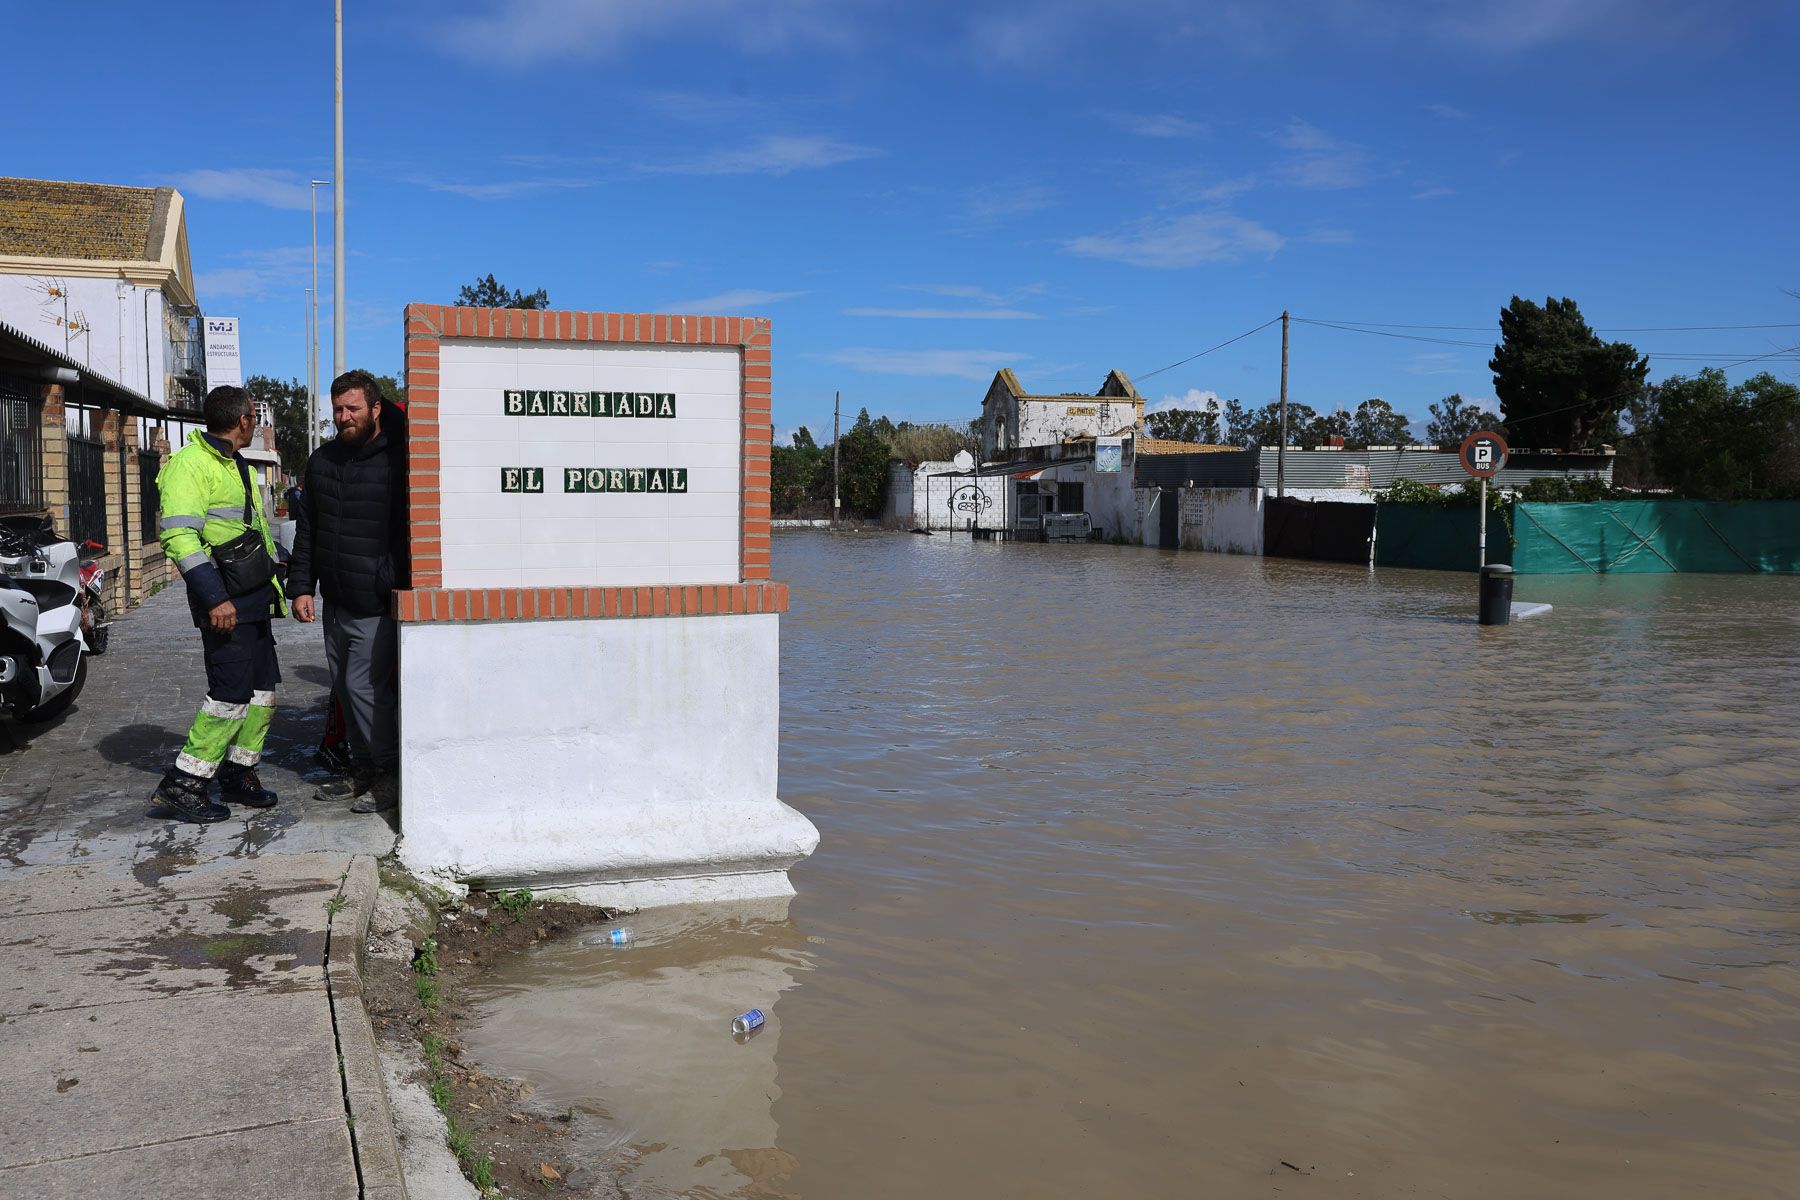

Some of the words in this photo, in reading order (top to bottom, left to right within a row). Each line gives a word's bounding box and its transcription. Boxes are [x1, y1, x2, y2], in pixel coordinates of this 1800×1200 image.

[209, 322, 233, 332] MJ
[209, 343, 236, 351] ANDAMIOS
[506, 391, 674, 416] BARRIADA
[1478, 449, 1488, 460] P
[1476, 462, 1490, 470] BUS
[503, 469, 542, 491] EL
[566, 469, 686, 491] PORTAL
